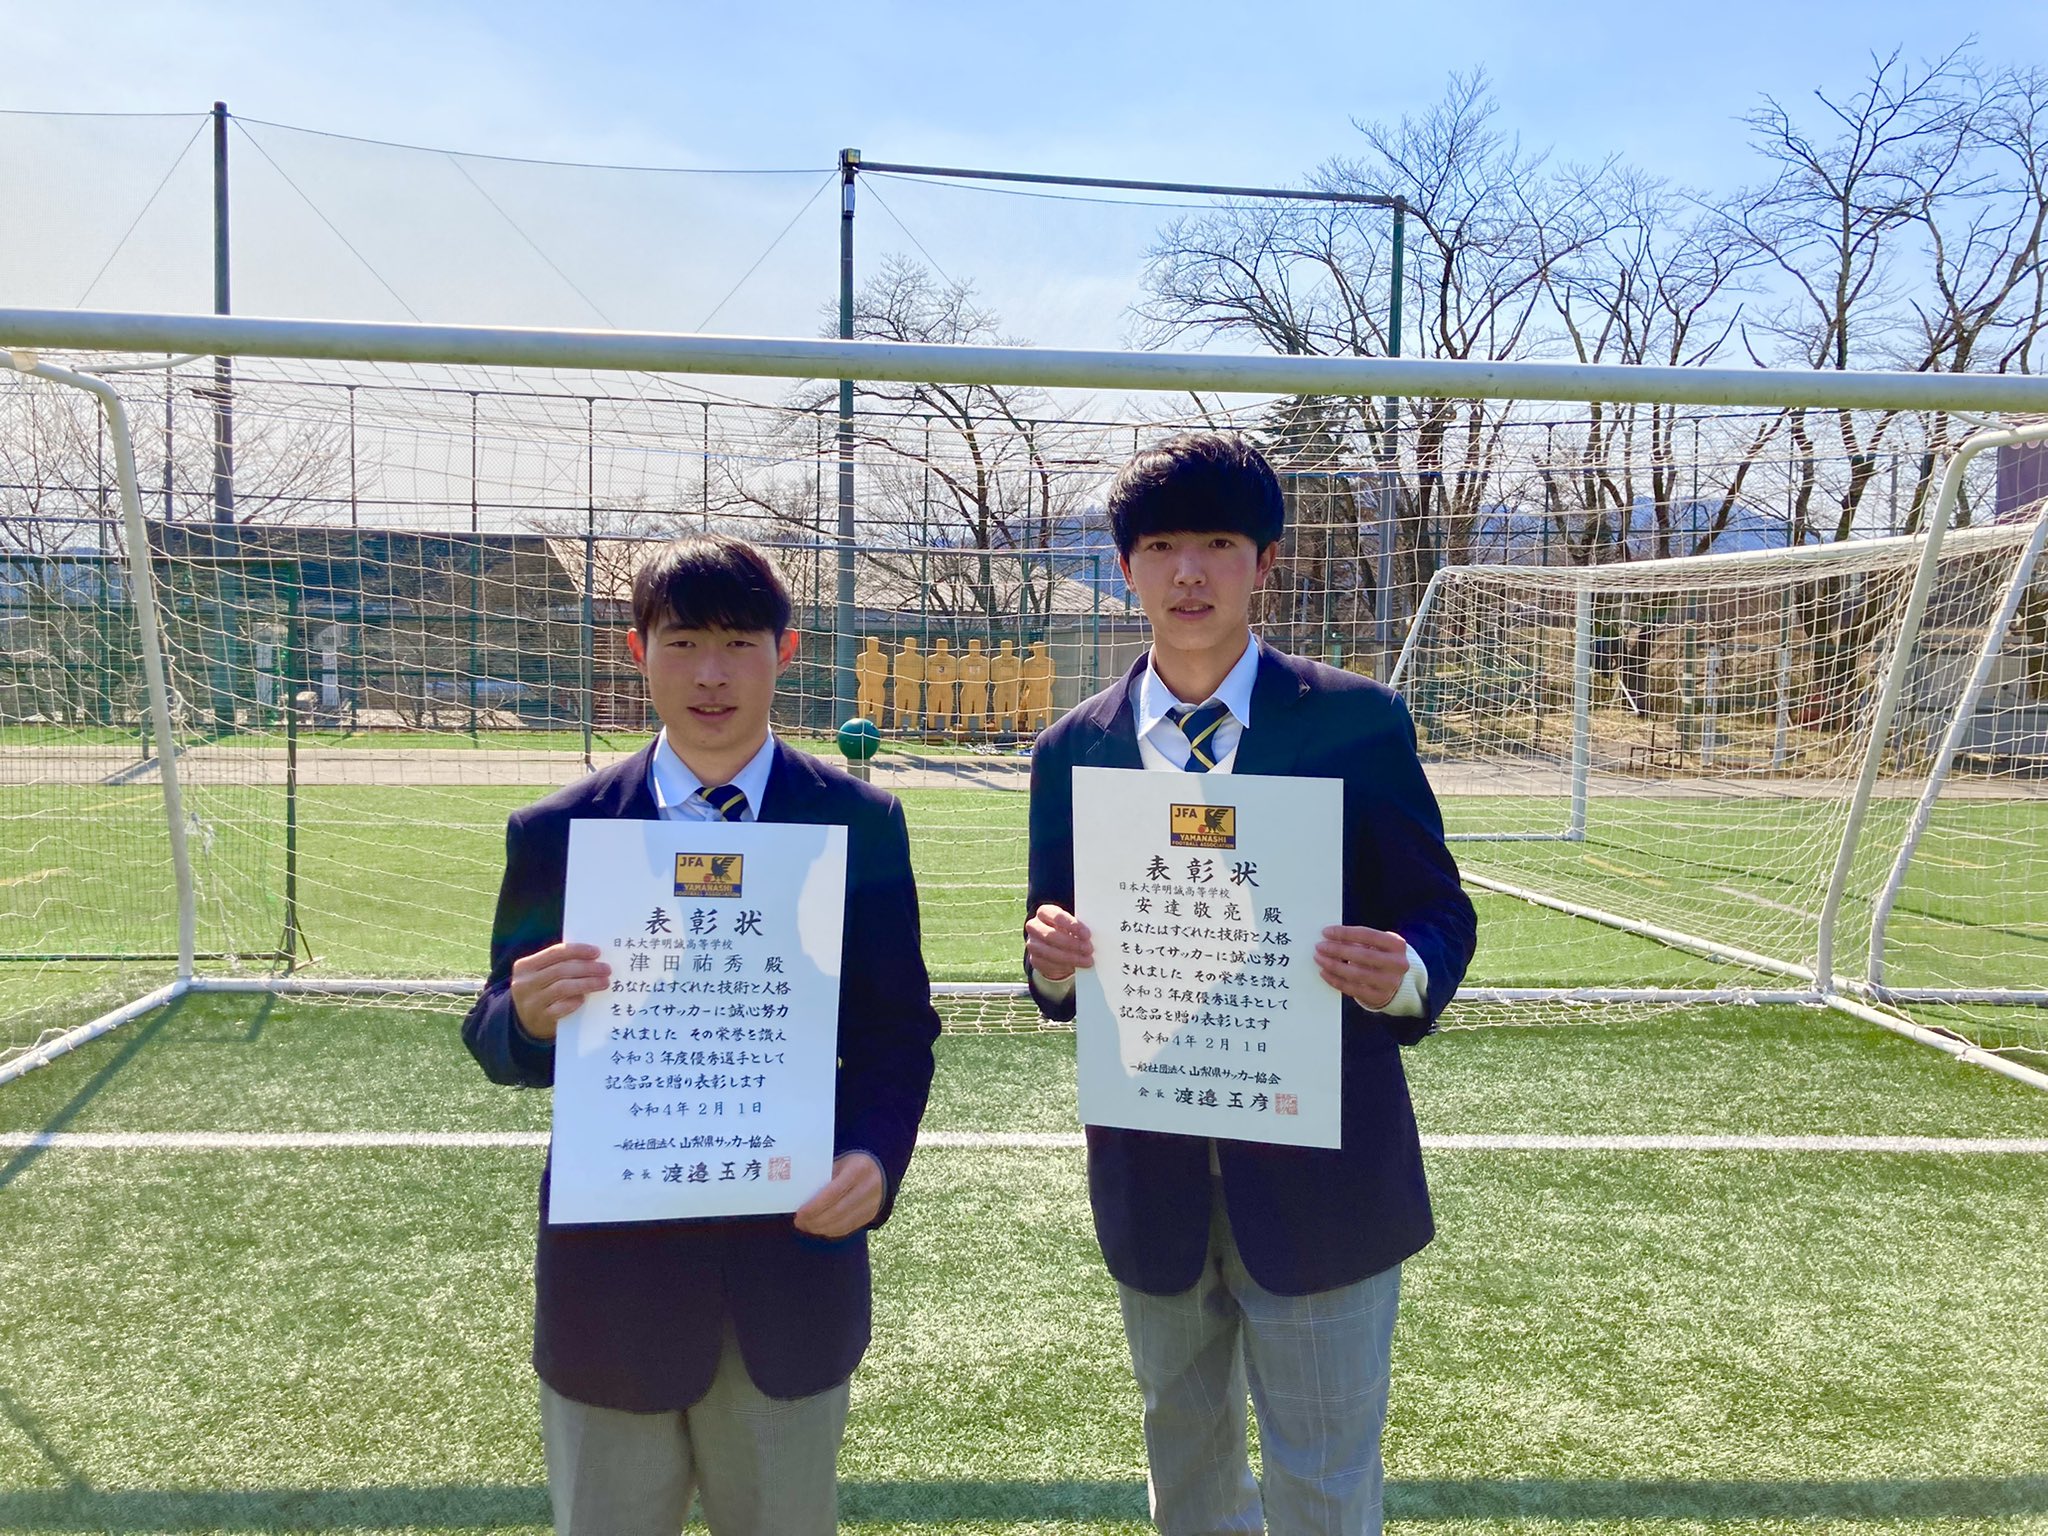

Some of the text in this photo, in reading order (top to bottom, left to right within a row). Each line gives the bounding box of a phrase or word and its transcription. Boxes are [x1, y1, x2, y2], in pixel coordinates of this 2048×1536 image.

[1174, 807, 1198, 818] JFA
[1180, 834, 1227, 843] YAMANASHI
[679, 857, 704, 867] JFA
[1146, 855, 1260, 887] 表彰状
[684, 883, 733, 892] YAMANASHI
[1118, 881, 1231, 899] 日本大学明誠高等学校
[644, 906, 763, 936] 表彰状
[1120, 920, 1292, 945] あなたはすぐれた技術と人格
[613, 937, 734, 950] 日本大学明誠高等学校
[1120, 942, 1291, 967] をもってサッカーに誠心努力
[1121, 962, 1183, 979] されました
[611, 980, 792, 995] あなたはすぐれた技術と人格
[1122, 983, 1289, 1010] 令和3年度優秀選手として
[610, 1003, 789, 1018] をもってサッカーに誠心努力
[1119, 1006, 1271, 1030] 記念品を贈り表彰します
[609, 1027, 678, 1041] されました
[610, 1050, 785, 1066] 令和3年度優秀選手として
[604, 1073, 767, 1090] 記念品を贈り表彰します
